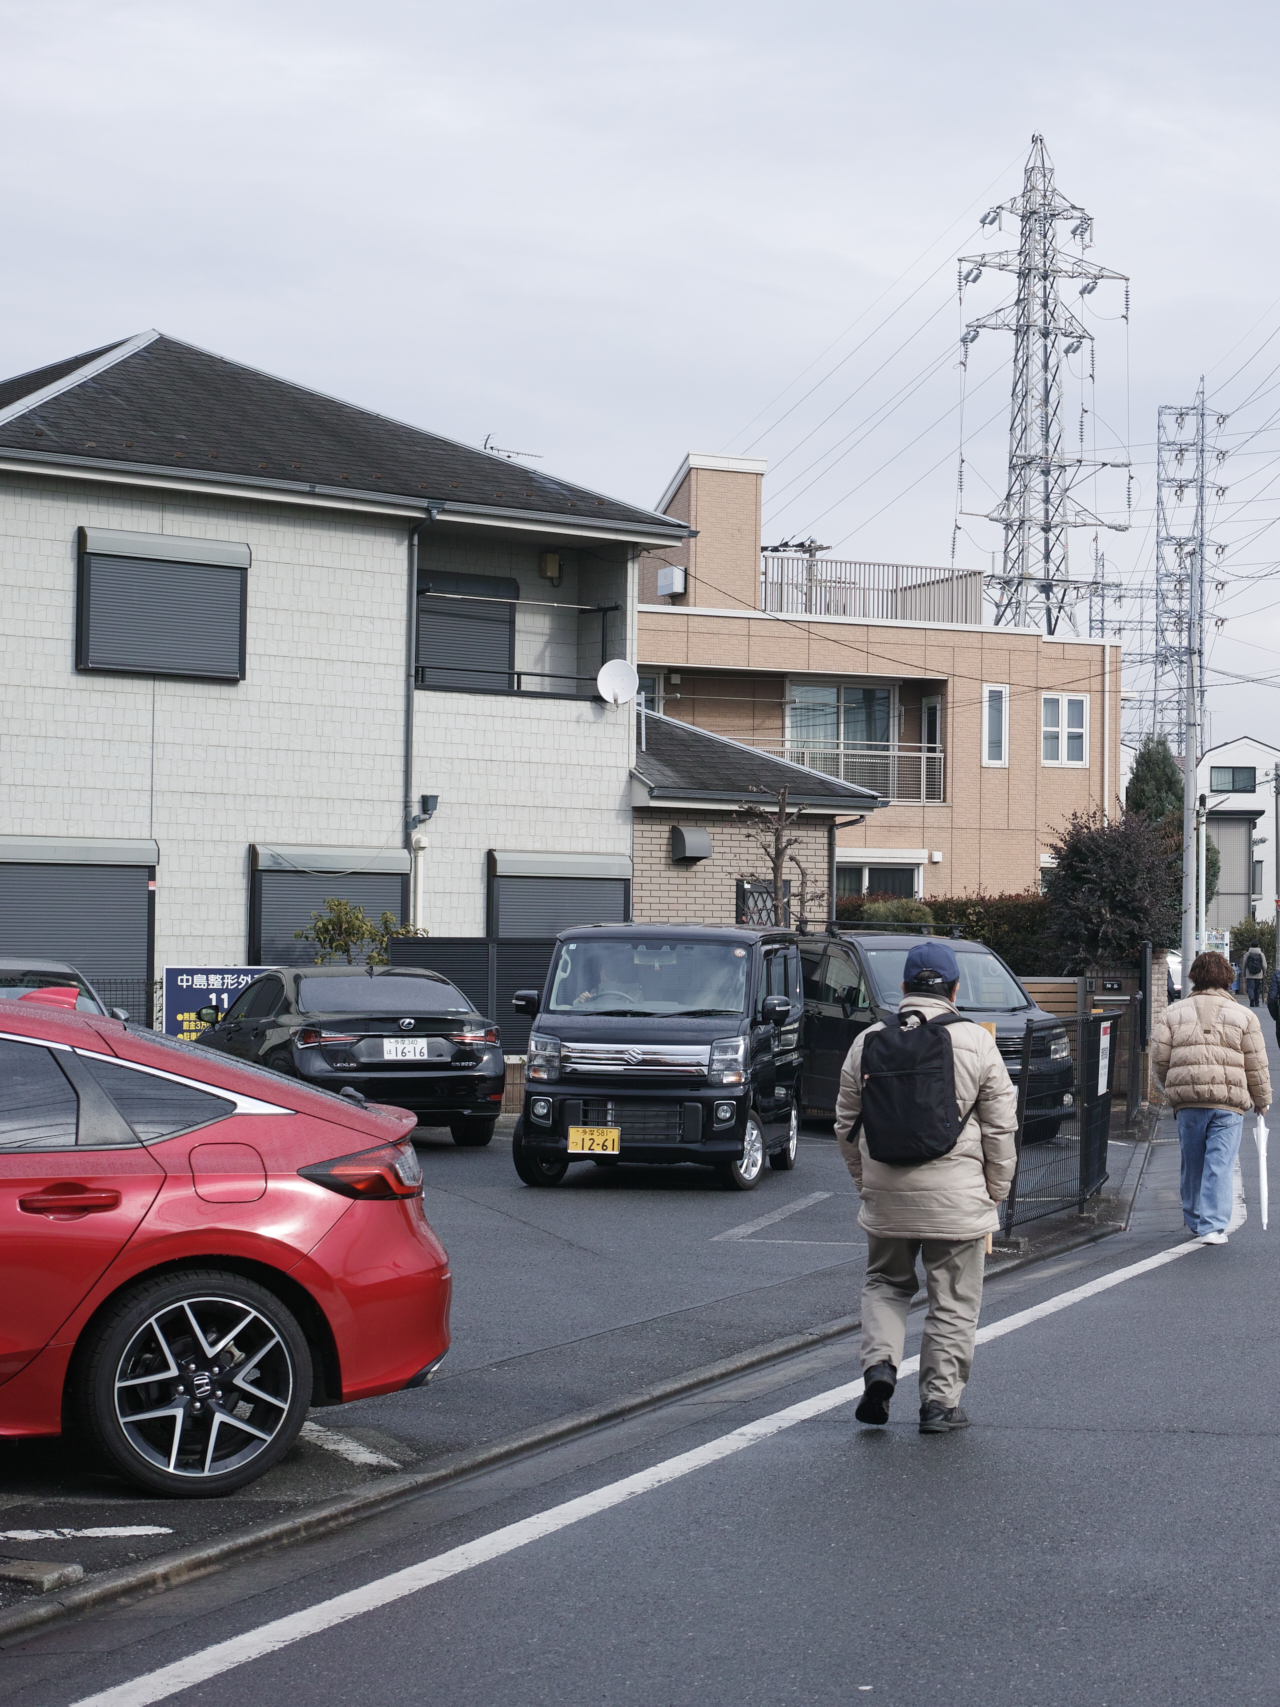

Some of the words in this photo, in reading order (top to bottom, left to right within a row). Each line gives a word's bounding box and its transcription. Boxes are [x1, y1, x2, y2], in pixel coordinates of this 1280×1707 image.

[177, 974, 260, 989] 中島整形外
[395, 1046, 426, 1058] 16-16
[581, 1128, 596, 1136] 多摩
[596, 1129, 608, 1137] 581
[581, 1137, 615, 1151] 12-61
